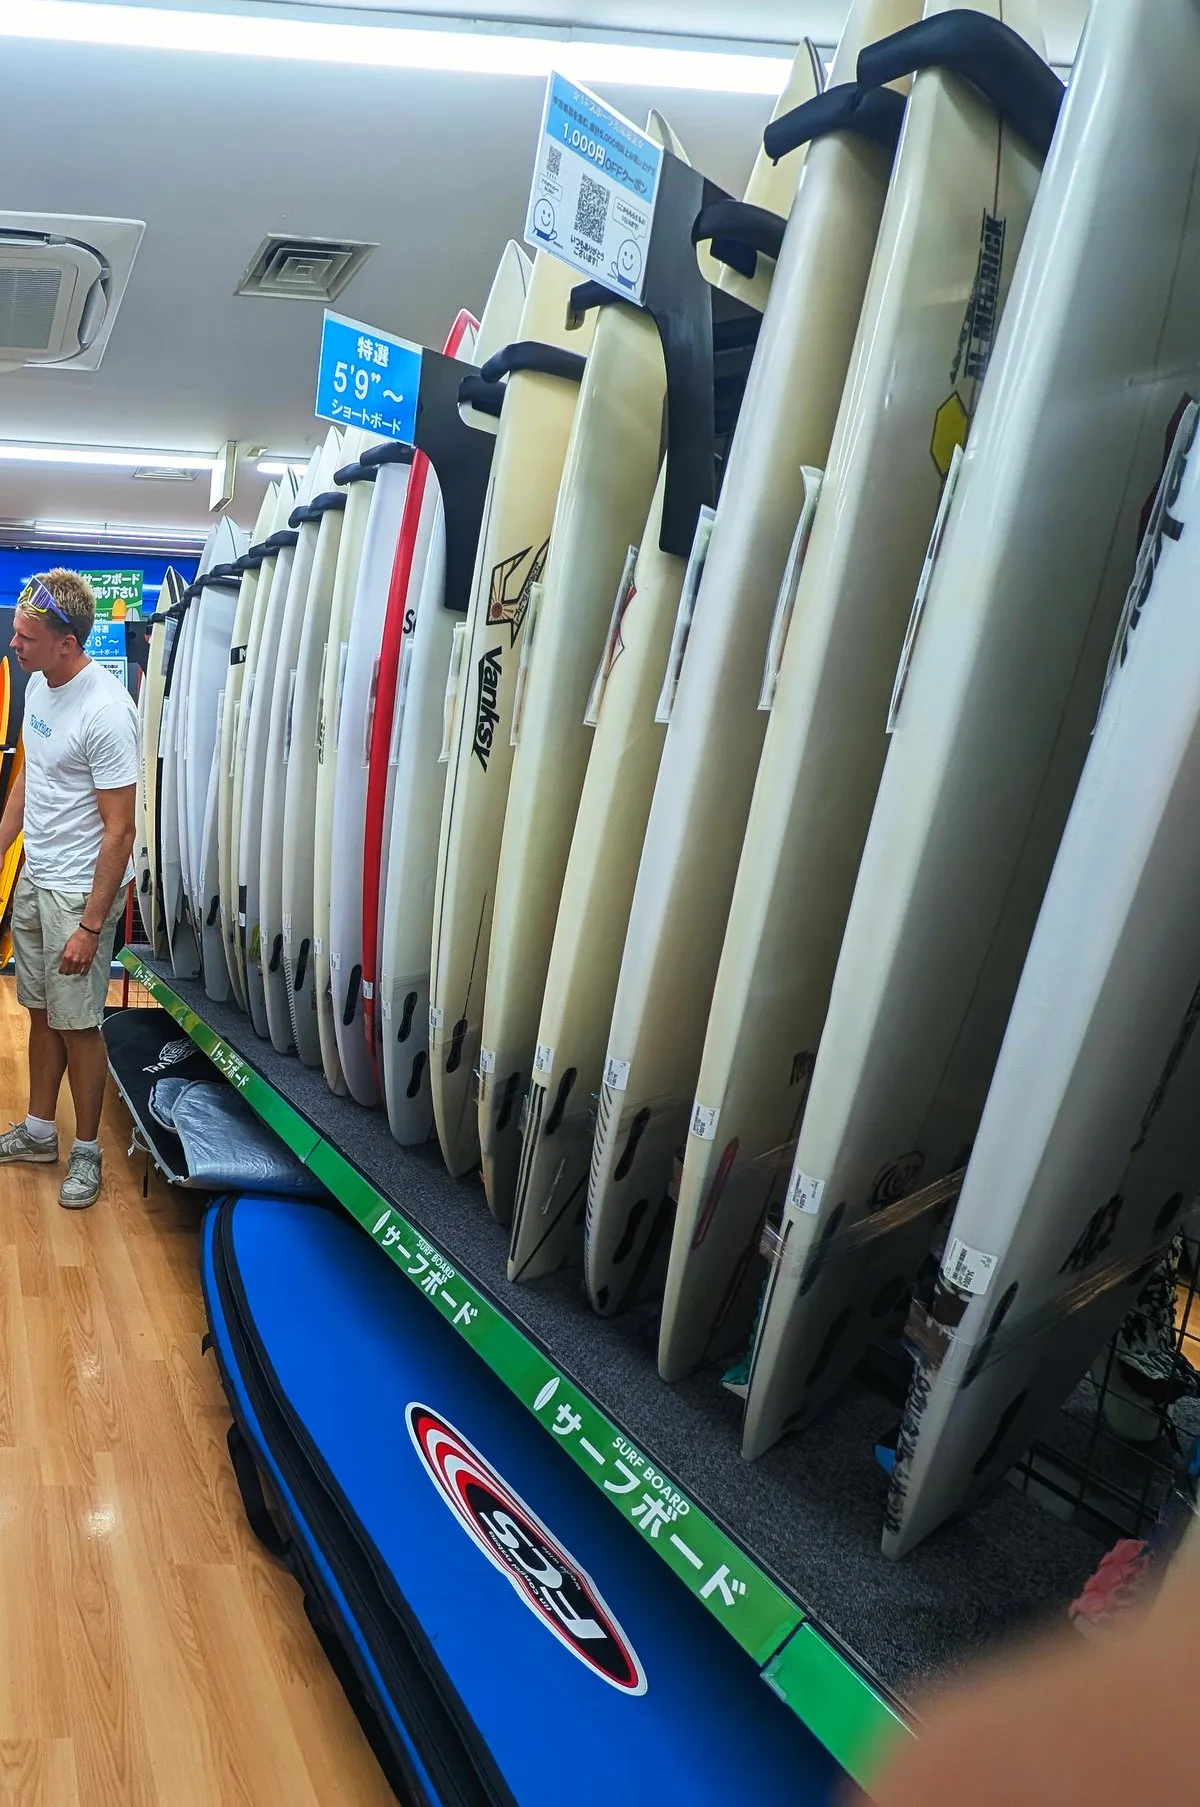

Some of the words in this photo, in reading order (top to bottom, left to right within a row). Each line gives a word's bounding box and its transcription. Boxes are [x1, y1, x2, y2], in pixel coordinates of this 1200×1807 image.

[357, 336, 389, 367] 特選
[332, 399, 401, 435] ショートボード
[82, 573, 141, 585] サーフボード
[94, 625, 109, 633] 特選
[214, 1049, 249, 1087] サーフボード
[381, 1225, 478, 1325] サーフボード
[416, 1240, 433, 1256] SURF
[432, 1253, 455, 1279] BOARD
[612, 1436, 645, 1468] SURF
[642, 1467, 690, 1516] BOARD
[552, 1403, 746, 1607] サーフボード
[488, 1530, 513, 1562] systems
[479, 1510, 608, 1639] FCS
[511, 1563, 540, 1596] control
